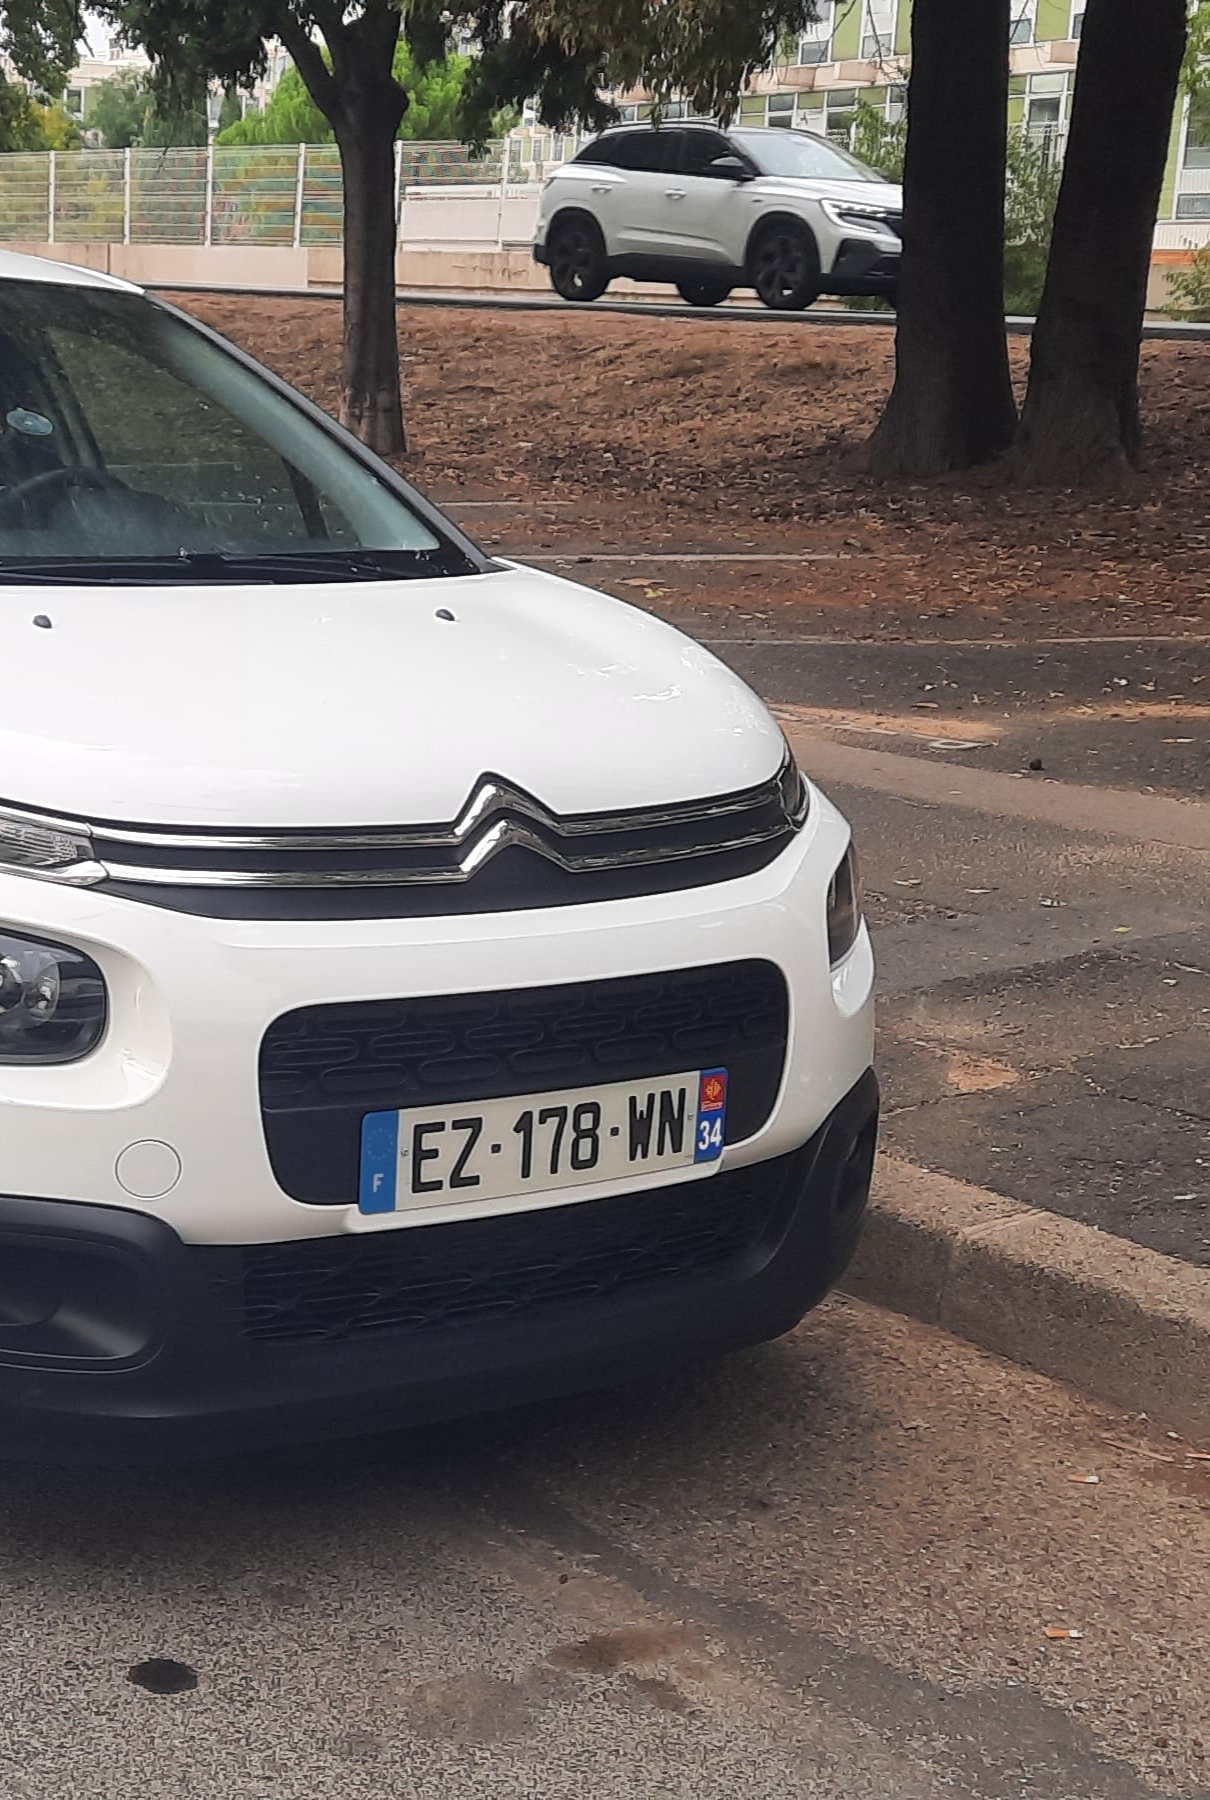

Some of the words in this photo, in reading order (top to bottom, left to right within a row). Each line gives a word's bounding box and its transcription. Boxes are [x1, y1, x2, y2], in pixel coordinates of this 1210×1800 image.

[410, 1087, 687, 1194] EZ-178-WN
[698, 1116, 723, 1151] 34
[372, 1172, 385, 1193] F
